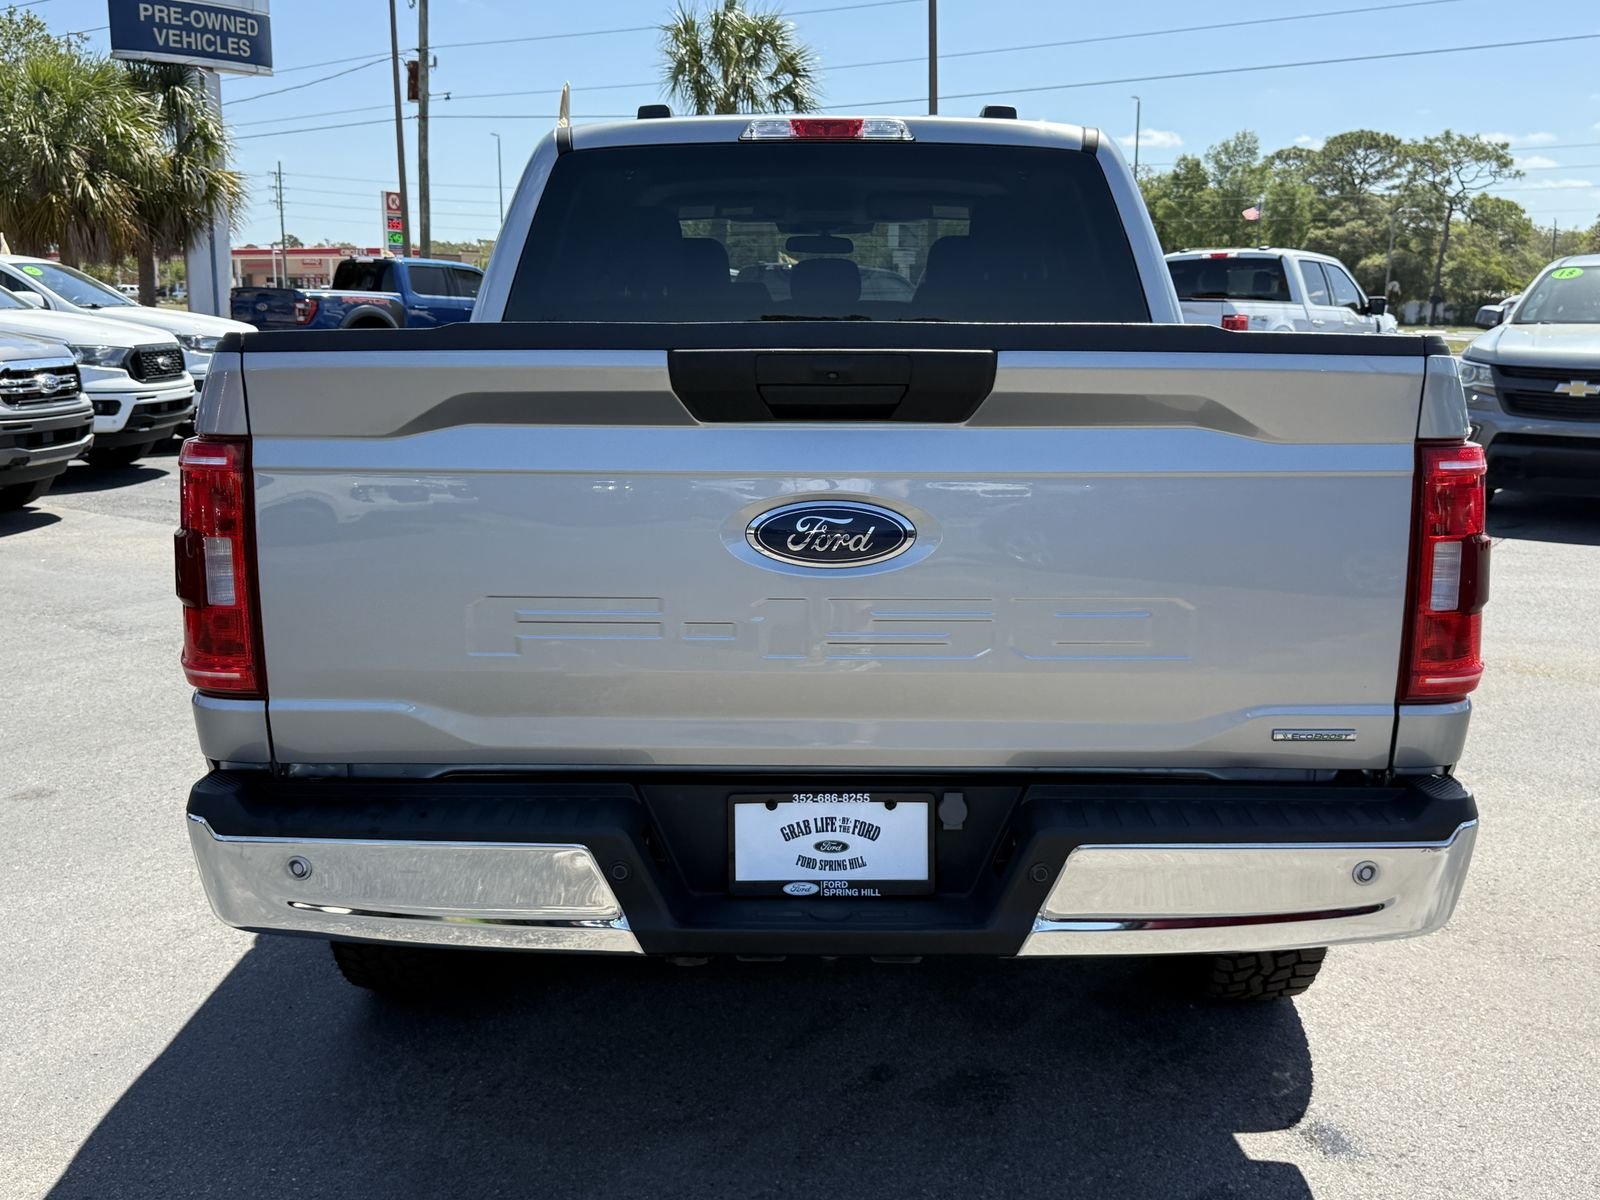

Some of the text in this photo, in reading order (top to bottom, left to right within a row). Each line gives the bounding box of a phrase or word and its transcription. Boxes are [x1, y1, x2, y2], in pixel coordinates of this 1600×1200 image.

[138, 3, 259, 37] PRE-OWNED
[153, 27, 251, 57] VEHICLES
[786, 515, 876, 552] Ford
[466, 596, 1196, 661] F-150
[792, 793, 871, 803] 352-686-8255
[780, 819, 812, 842] GRAB
[813, 816, 837, 833] LIFE
[838, 824, 850, 833] THE
[851, 819, 881, 842] FORD
[820, 841, 843, 851] Ford
[795, 854, 867, 872] FORD SPRING HILL
[789, 883, 812, 894] Ford
[823, 880, 848, 889] FORD
[823, 888, 881, 896] SPRING HILL
